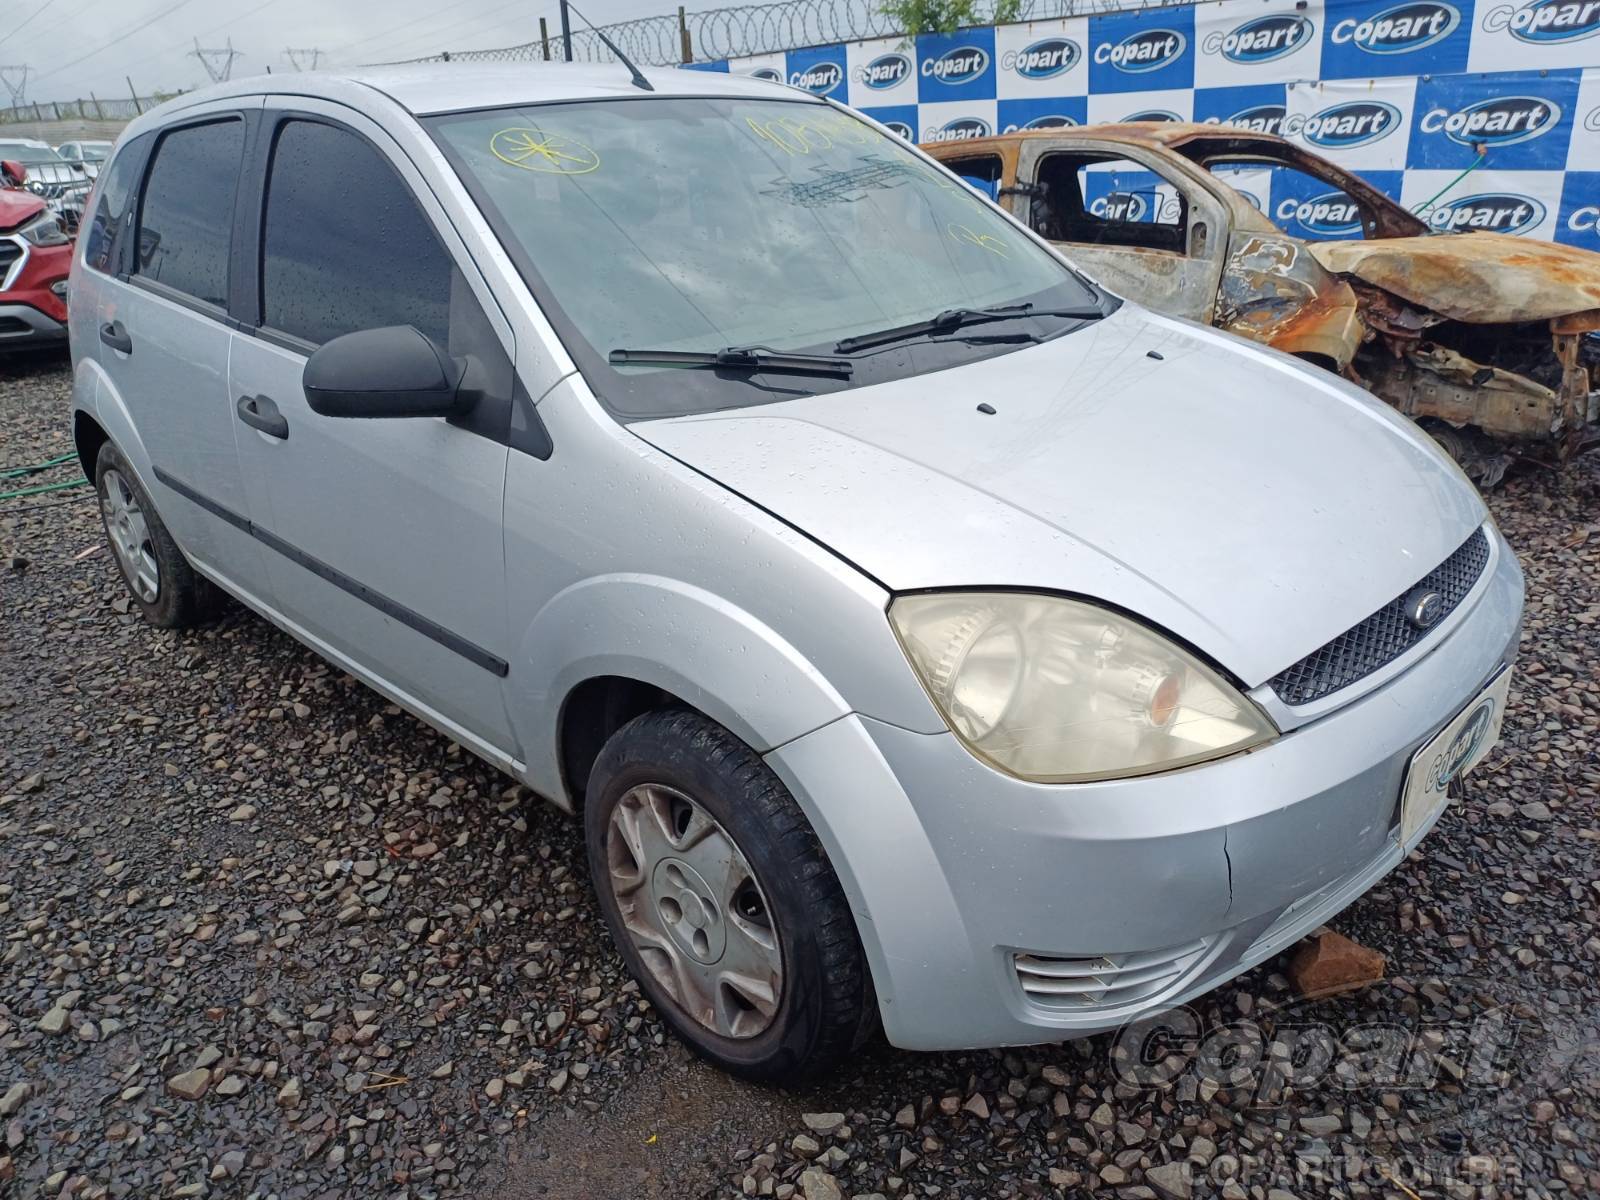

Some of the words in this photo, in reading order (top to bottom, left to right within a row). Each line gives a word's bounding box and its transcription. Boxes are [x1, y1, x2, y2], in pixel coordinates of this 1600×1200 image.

[1331, 9, 1446, 45] Copart
[1482, 0, 1600, 34] Copar
[1094, 35, 1176, 65] Copart
[1202, 23, 1300, 56] Copart
[921, 52, 982, 79] Copart
[1001, 46, 1072, 73] Copart
[789, 65, 837, 91] Copart
[1284, 109, 1386, 140] Copart
[1420, 104, 1544, 137] Copart
[1276, 198, 1359, 225] Copar
